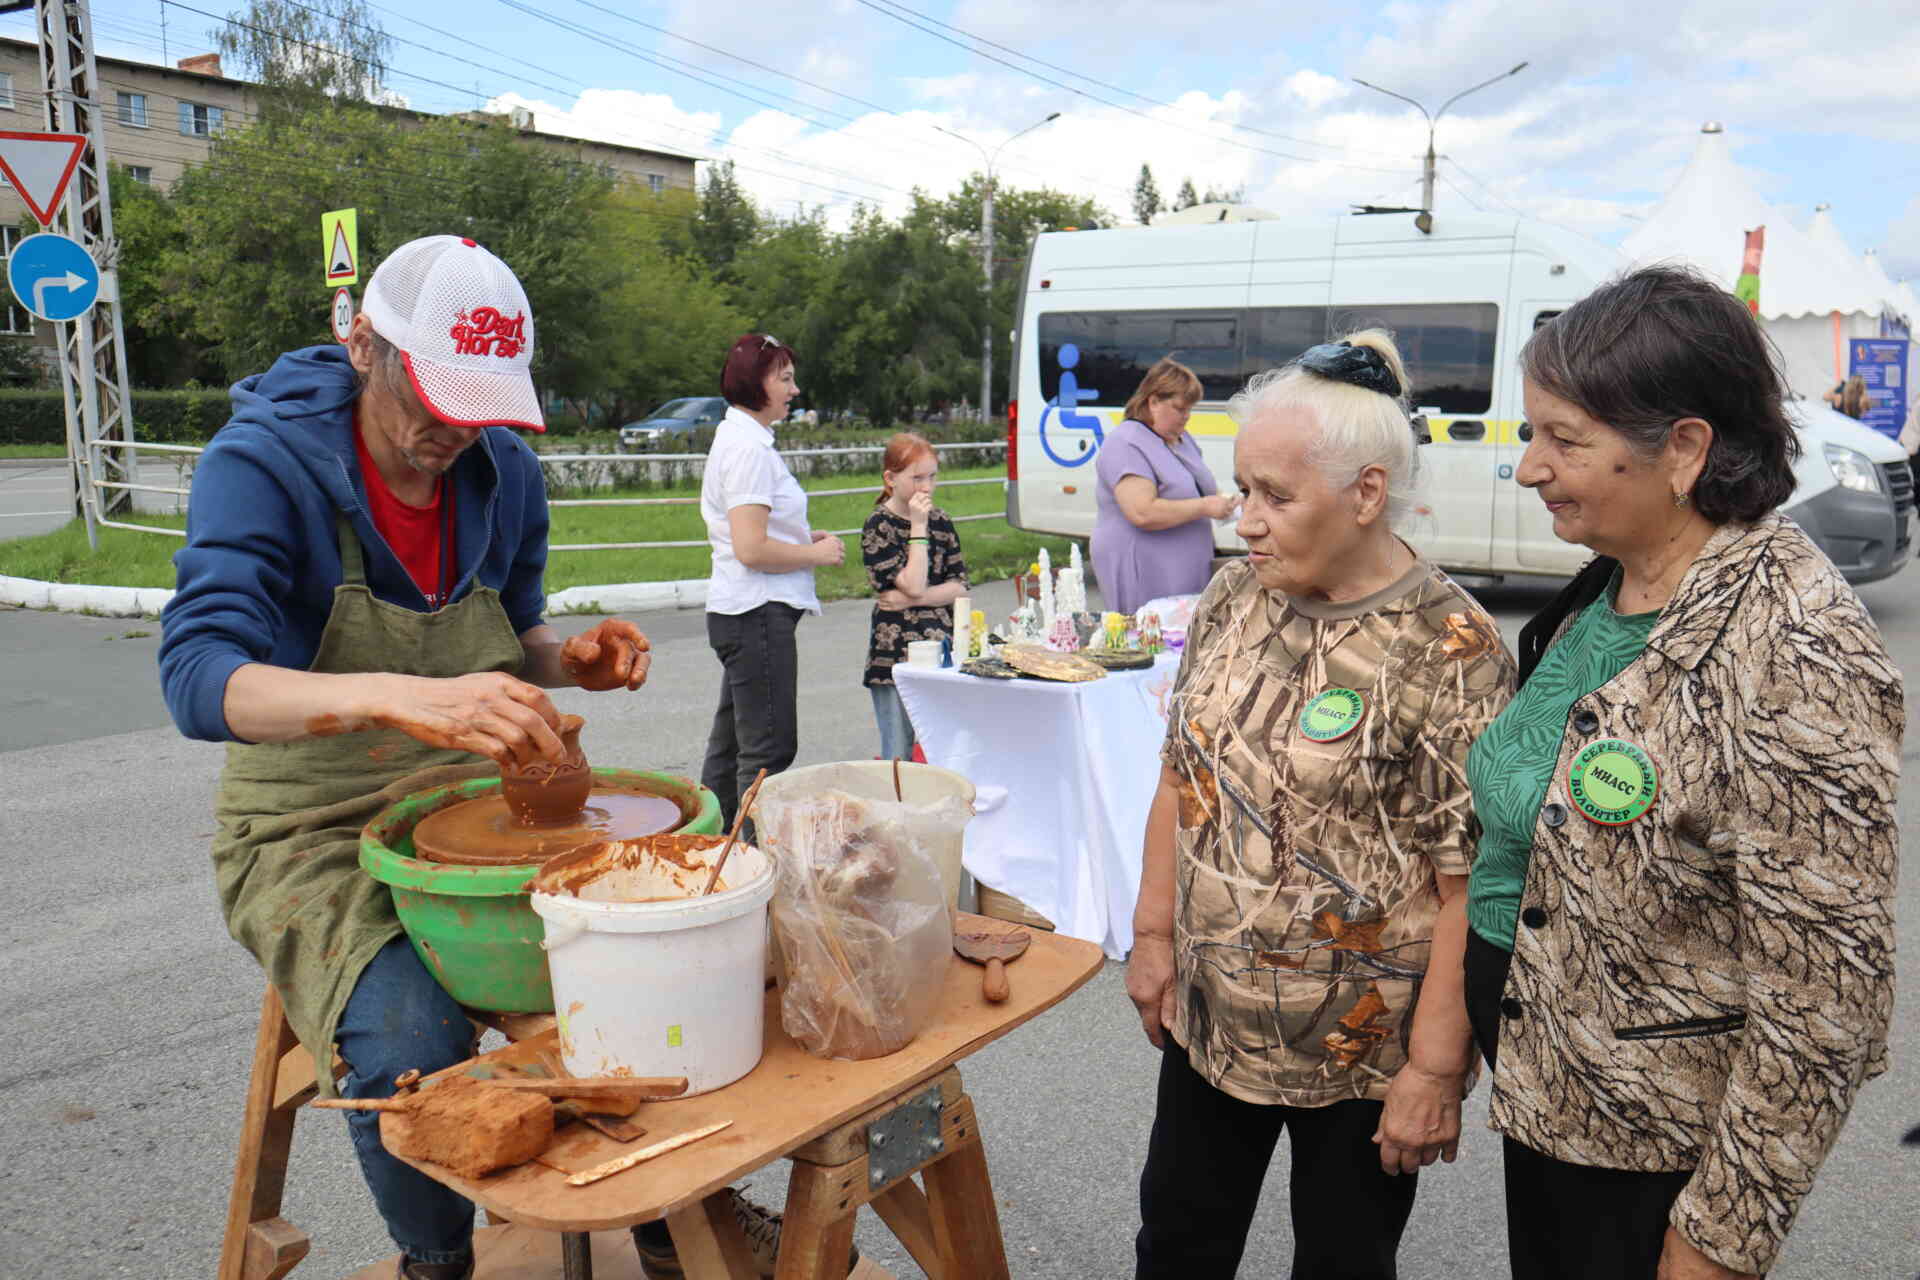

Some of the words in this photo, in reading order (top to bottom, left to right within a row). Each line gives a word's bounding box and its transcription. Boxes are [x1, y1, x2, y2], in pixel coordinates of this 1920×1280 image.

[338, 304, 349, 326] 20
[1590, 766, 1635, 796] МИАСС
[1571, 778, 1631, 821] ВОЛОНТЕР
